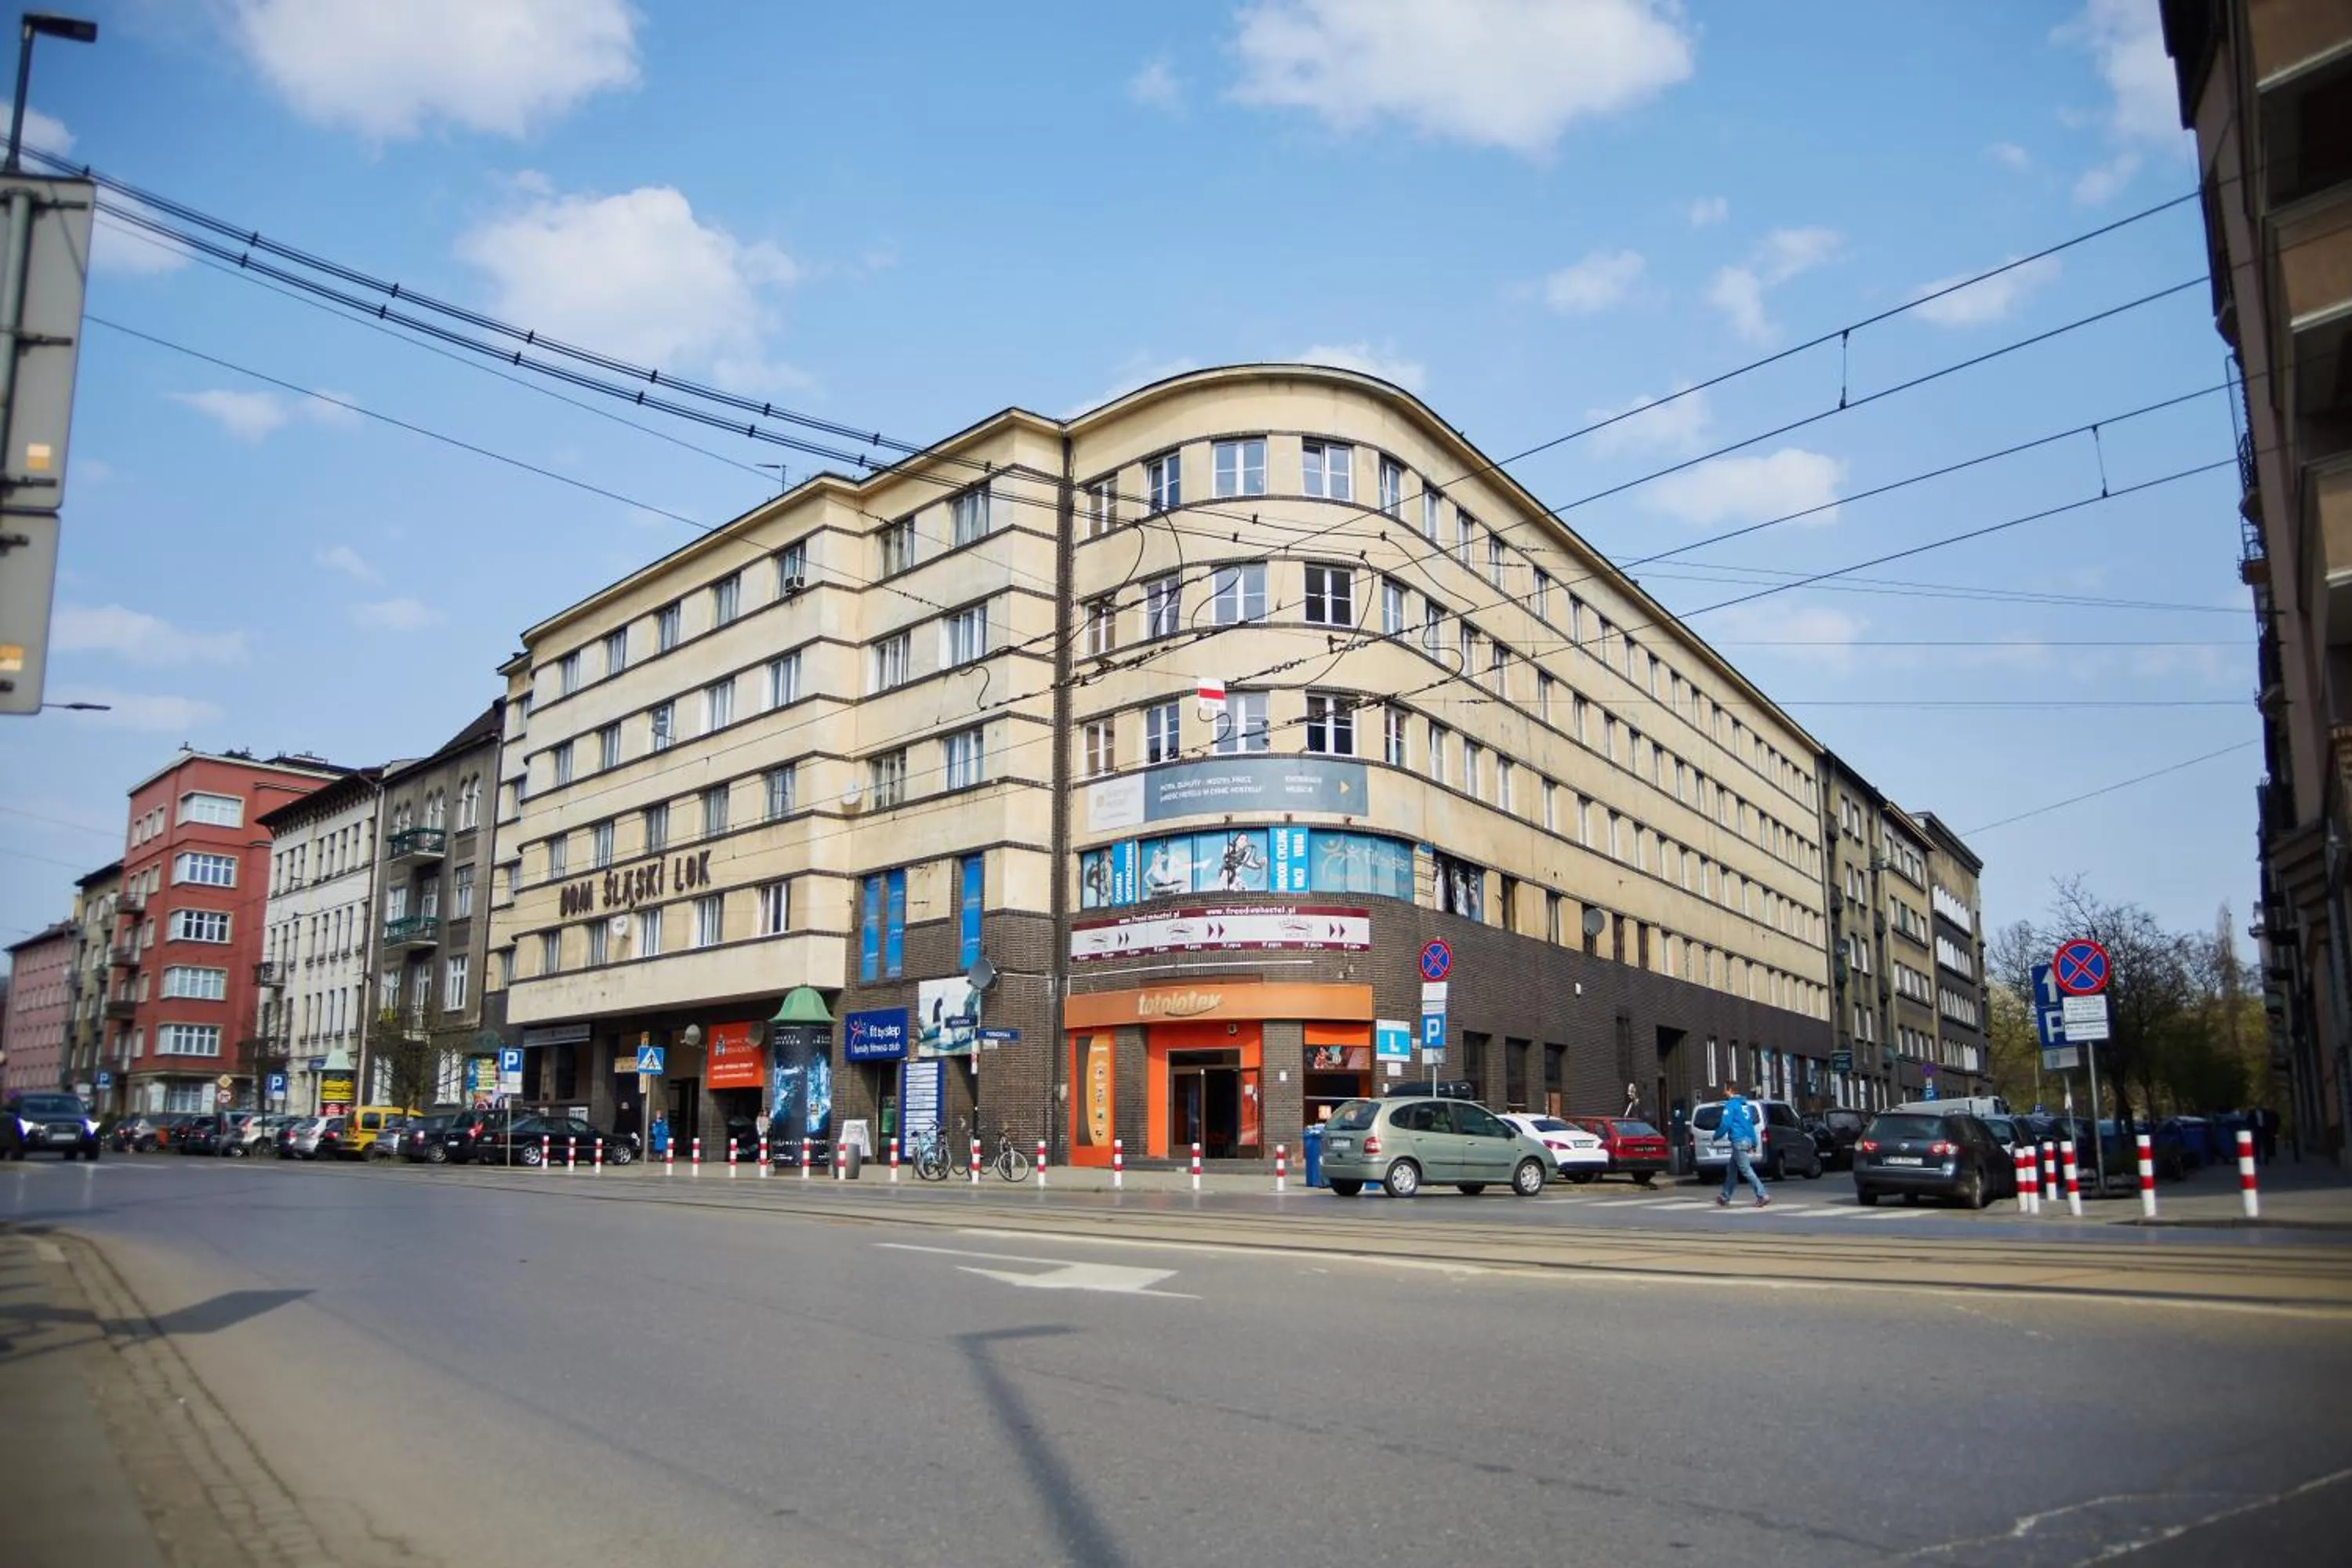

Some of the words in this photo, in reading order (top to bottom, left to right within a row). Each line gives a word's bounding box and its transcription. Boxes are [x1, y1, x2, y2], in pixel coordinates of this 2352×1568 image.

[560, 879, 593, 917] DOM
[673, 849, 712, 892] LOK
[1426, 1018, 1440, 1044] P
[2045, 1010, 2065, 1043] P
[1388, 1032, 1400, 1054] L
[504, 1051, 519, 1070] P
[100, 1072, 109, 1083] P
[270, 1076, 283, 1090] P
